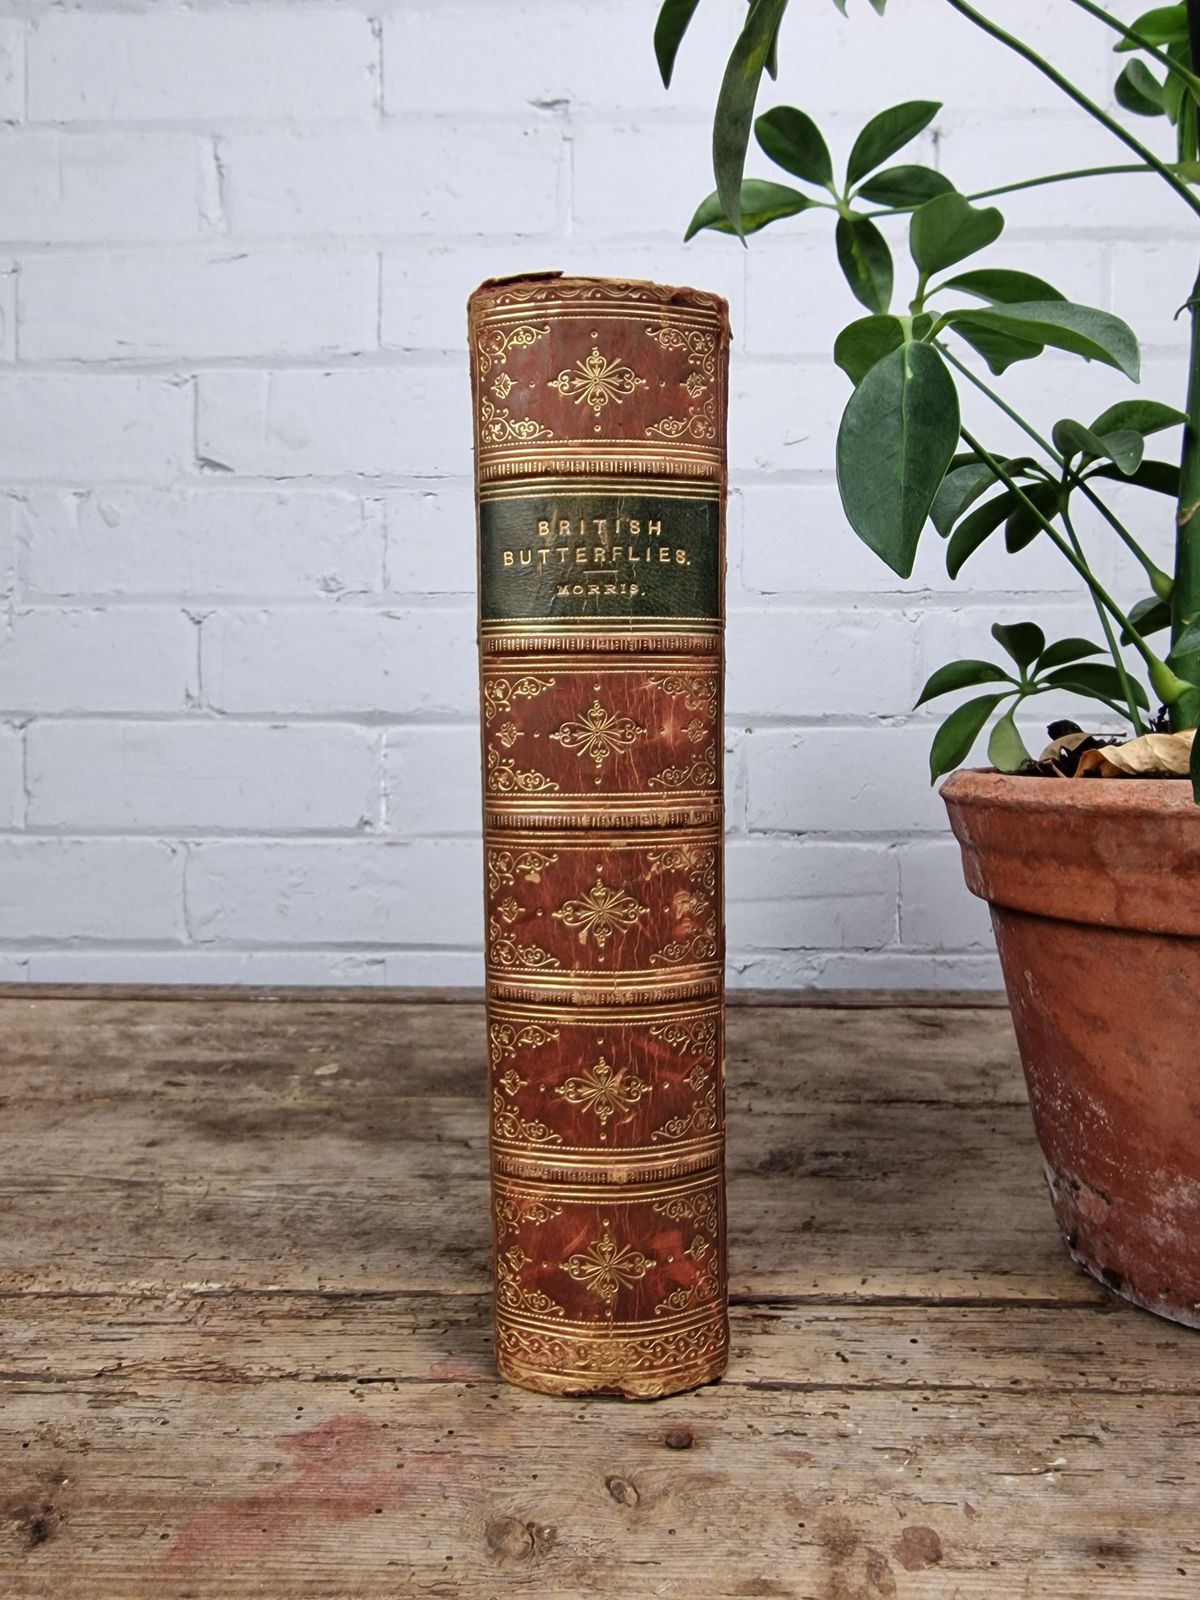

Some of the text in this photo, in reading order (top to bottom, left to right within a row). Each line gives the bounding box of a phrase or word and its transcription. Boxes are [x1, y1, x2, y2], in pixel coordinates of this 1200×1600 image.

[537, 518, 662, 536] BRITISH
[503, 546, 692, 566] BUTTERFLIES.
[556, 583, 646, 596] MORRIS.
